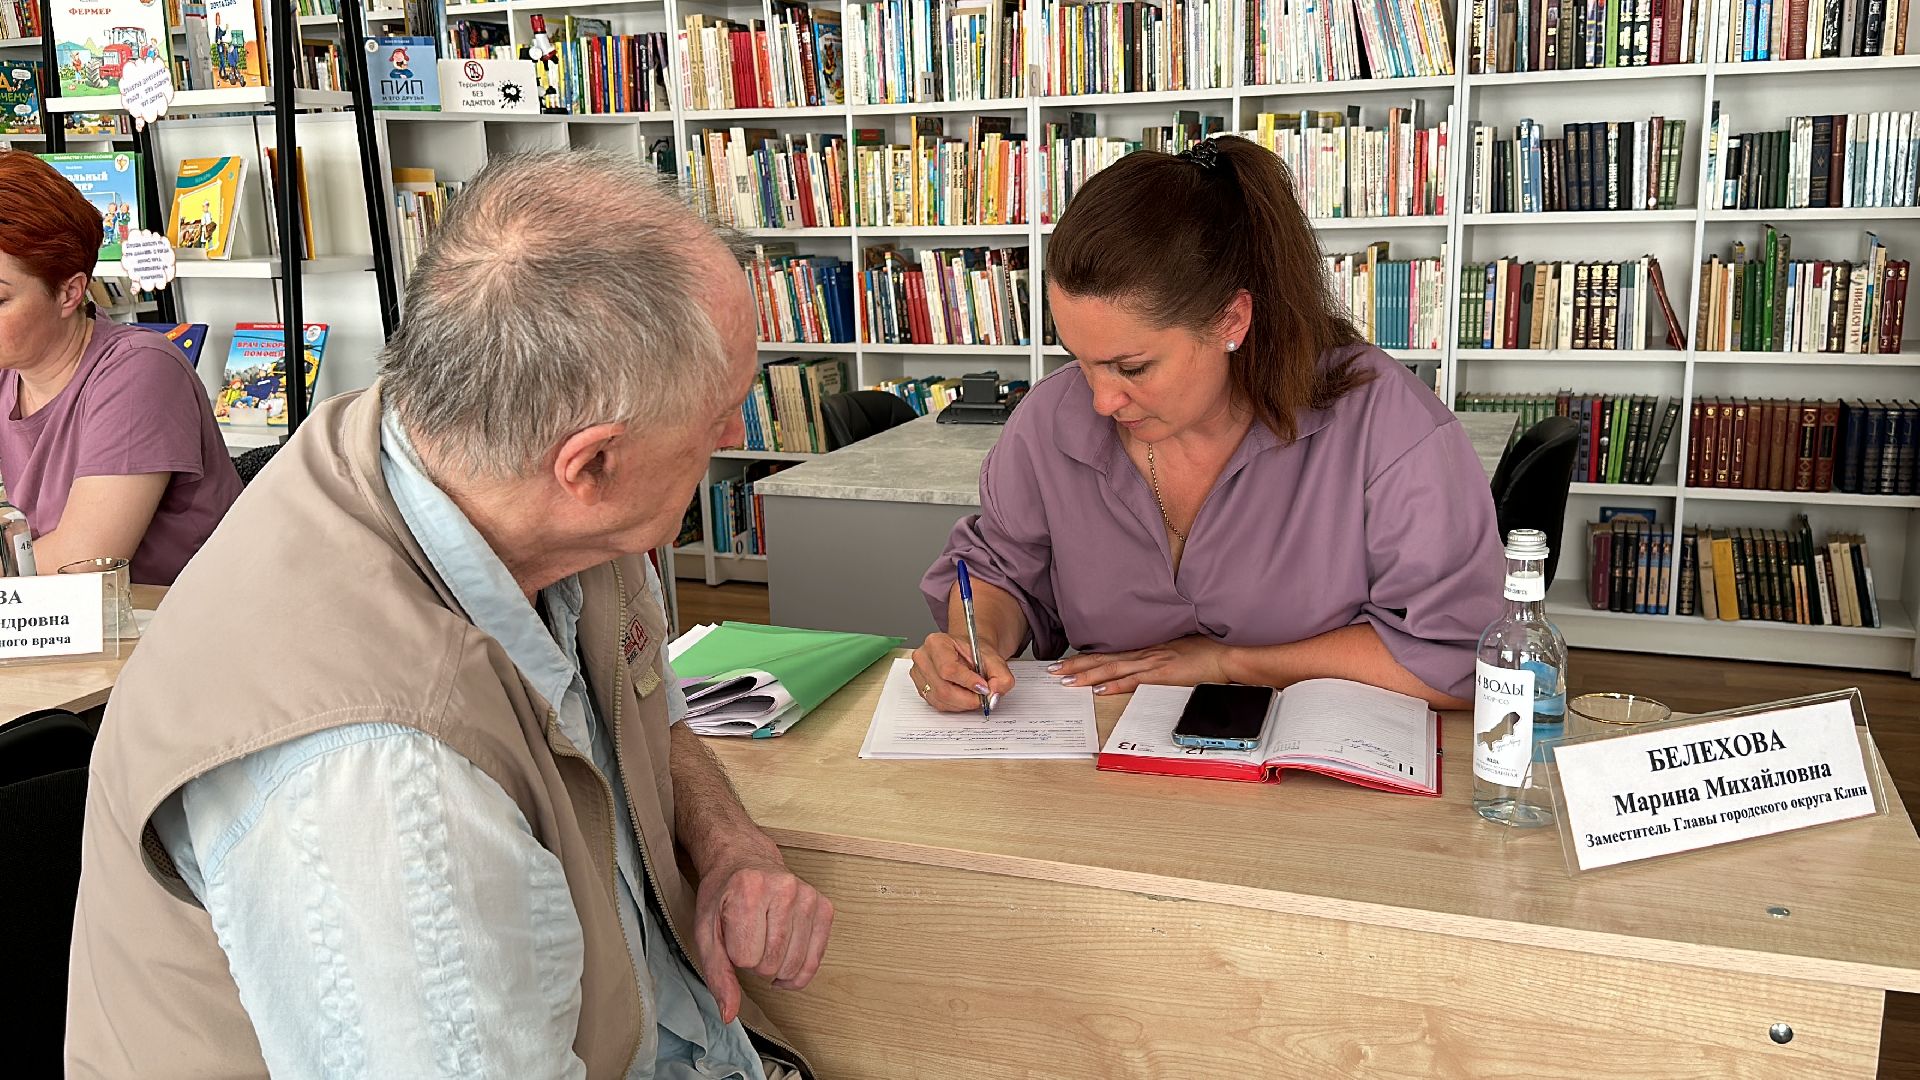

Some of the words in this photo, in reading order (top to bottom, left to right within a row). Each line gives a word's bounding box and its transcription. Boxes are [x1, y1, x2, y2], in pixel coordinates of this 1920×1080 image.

[381, 80, 423, 95] ПИП
[786, 205, 795, 221] Н
[1852, 287, 1864, 327] КУПРИН
[32, 636, 71, 649] врача
[1483, 676, 1524, 696] ВОДЫ
[1646, 729, 1786, 772] БЕЛЕХОВА
[1612, 786, 1700, 816] Марина
[1703, 763, 1832, 799] Михайловна
[1585, 823, 1671, 848] Заместитель
[1673, 814, 1717, 832] Главы
[1720, 800, 1788, 823] городского
[1790, 792, 1832, 810] округа
[1834, 785, 1868, 801] Клин
